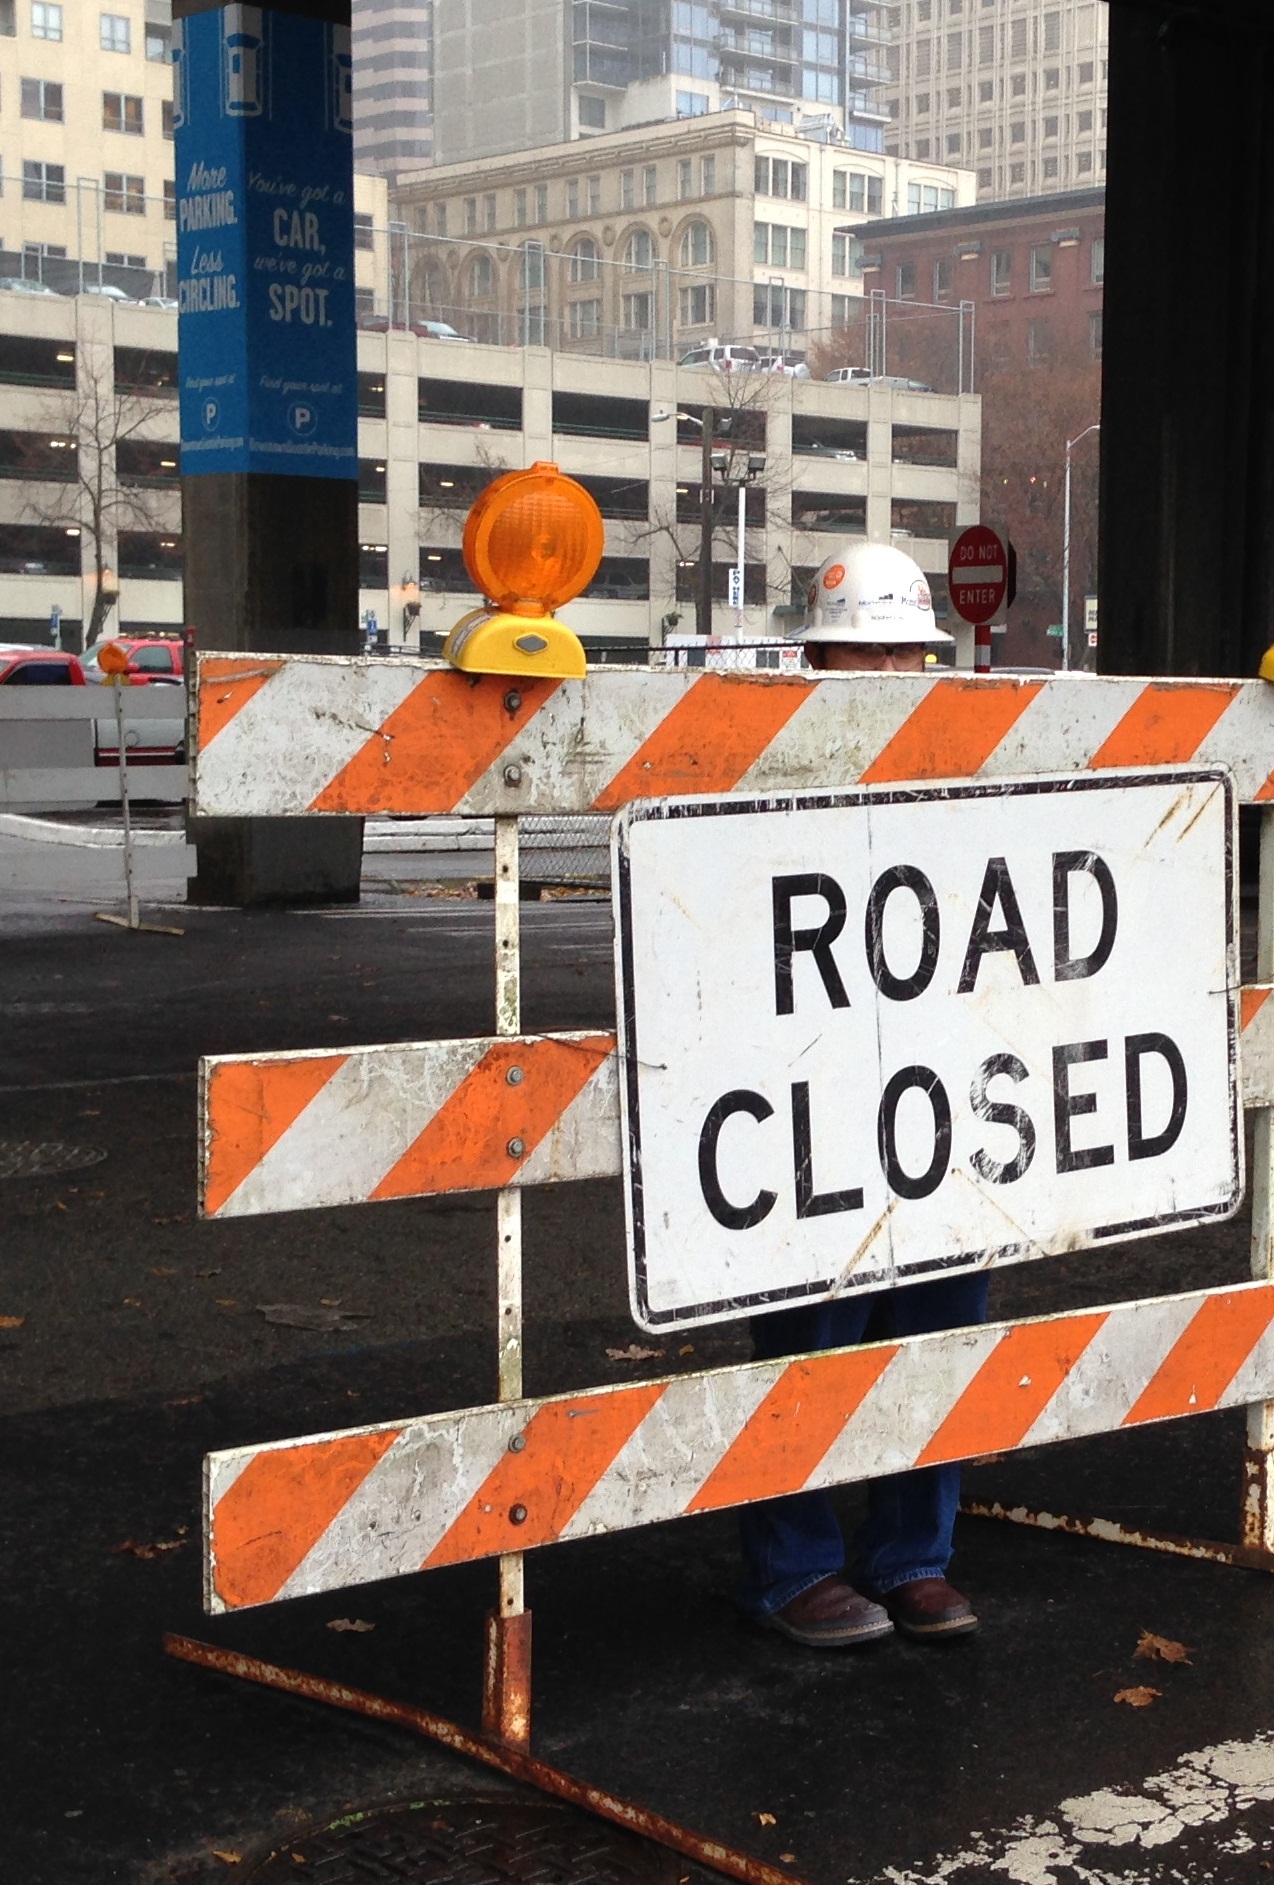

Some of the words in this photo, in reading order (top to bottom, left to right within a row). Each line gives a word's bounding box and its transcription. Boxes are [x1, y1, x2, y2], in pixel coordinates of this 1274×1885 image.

[187, 160, 227, 193] More
[248, 170, 296, 197] You've
[300, 185, 329, 210] got
[333, 190, 345, 205] a
[179, 189, 238, 232] PARKING.
[273, 207, 326, 256] CAR,
[191, 245, 224, 275] Less
[254, 252, 298, 275] we've
[300, 261, 329, 286] got
[334, 266, 345, 280] a
[179, 273, 240, 314] CIRCLING.
[269, 282, 333, 326] SPOT.
[206, 403, 217, 425] P
[295, 407, 311, 429] P
[960, 545, 975, 560] DO
[978, 544, 998, 560] NOT
[960, 588, 996, 605] ENTER
[771, 850, 1118, 1017] ROAD
[697, 1032, 1189, 1231] CLOSED
